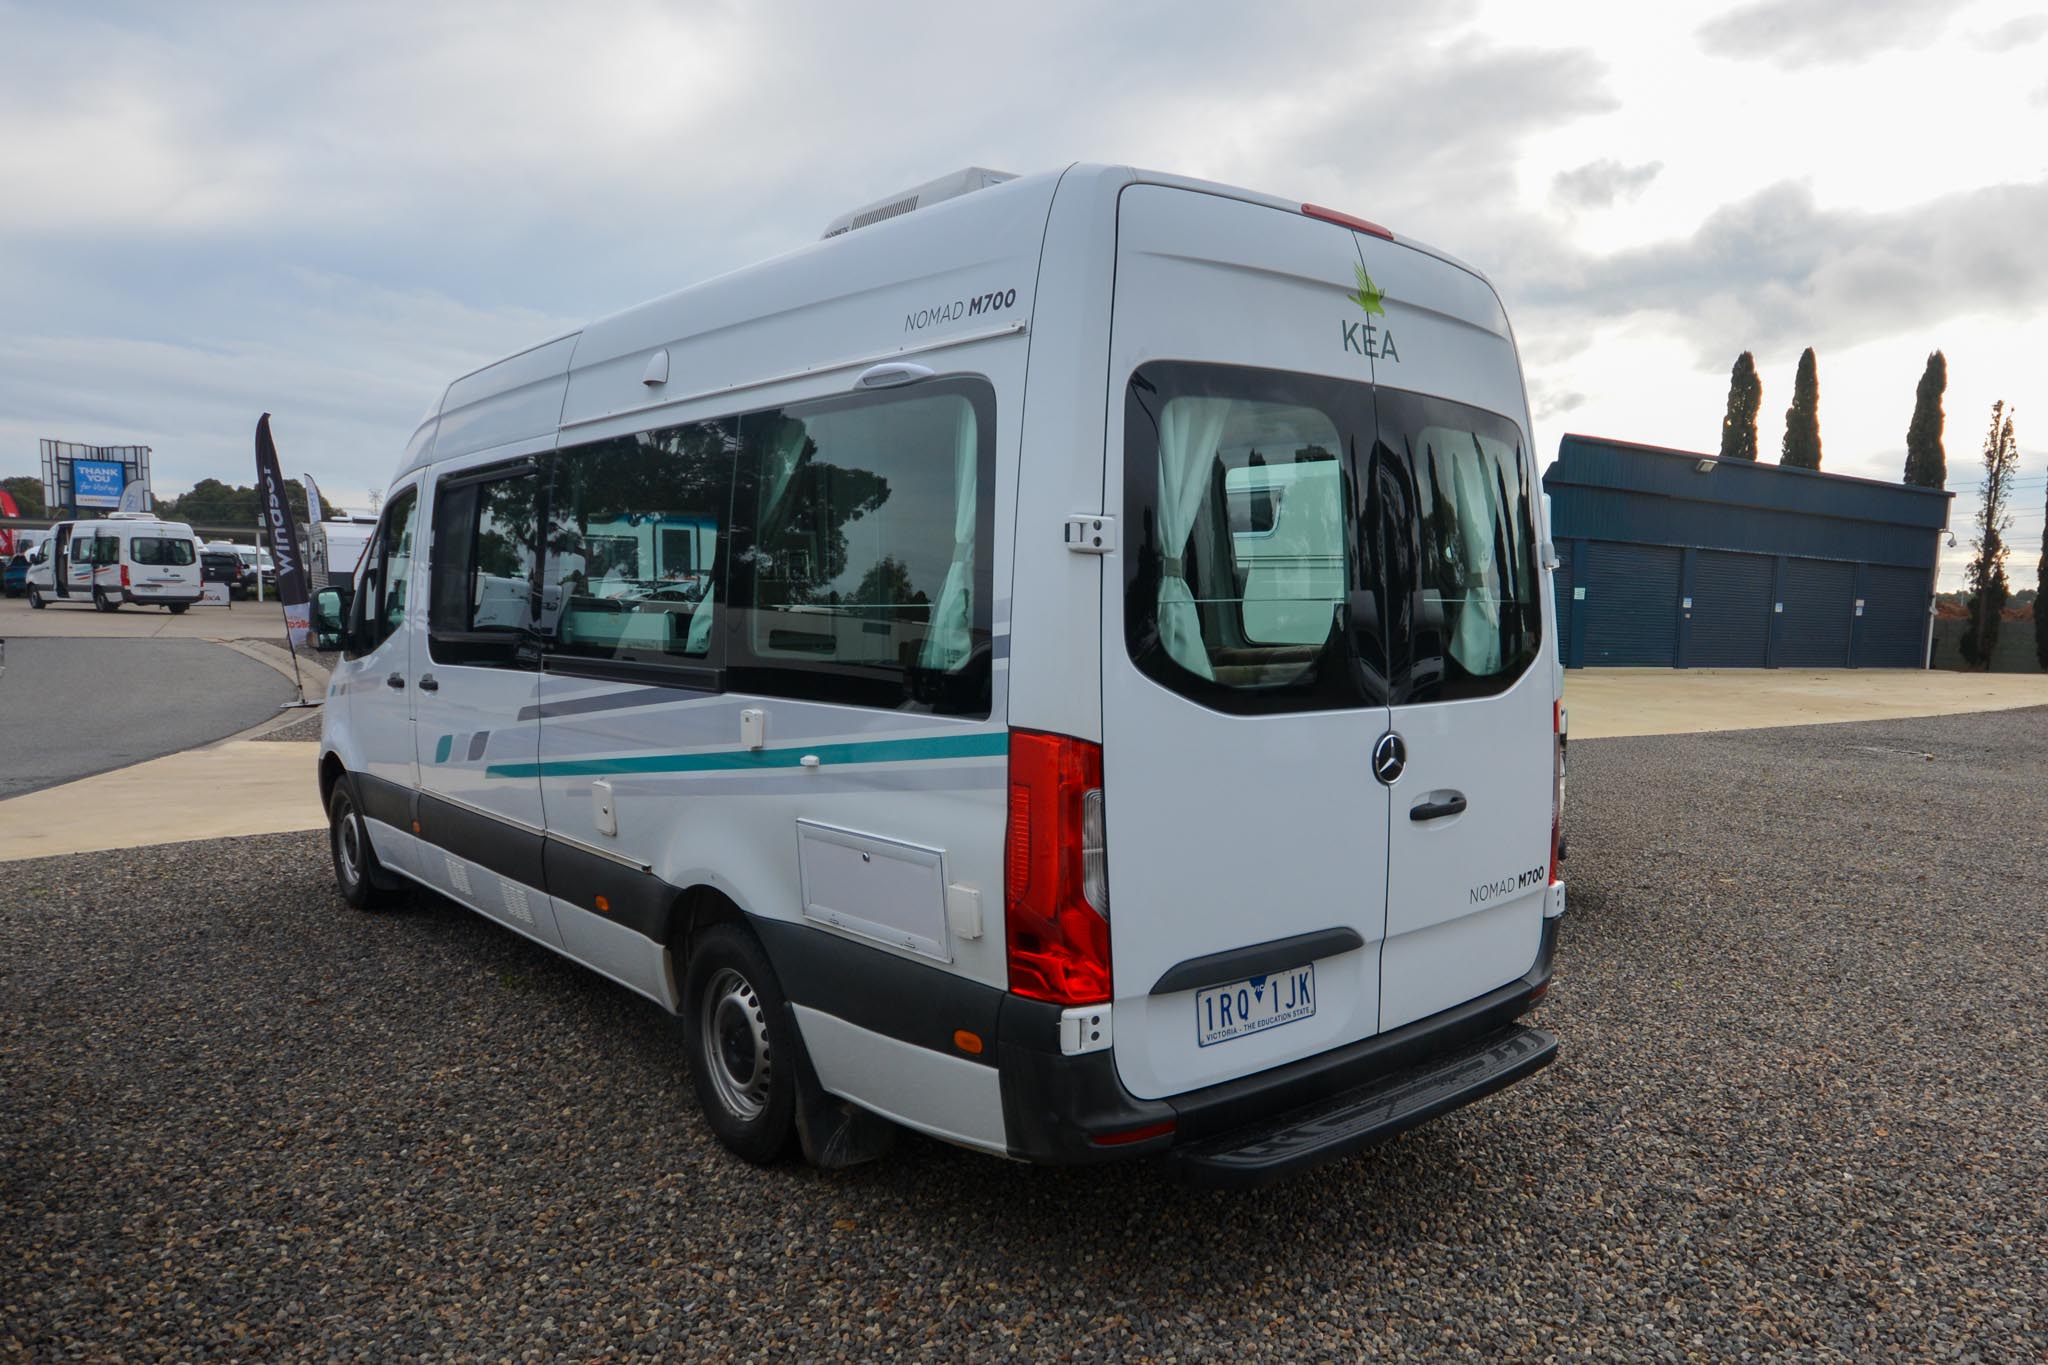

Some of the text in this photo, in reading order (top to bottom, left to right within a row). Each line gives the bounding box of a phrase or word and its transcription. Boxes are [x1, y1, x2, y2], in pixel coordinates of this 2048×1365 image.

[904, 288, 1016, 333] NOMAD M700
[1341, 319, 1400, 363] KEA
[78, 466, 118, 476] THANK
[87, 474, 111, 482] YOU
[1469, 865, 1544, 904] NOMAD M700
[1205, 972, 1311, 1031] 1RQ 1JK
[1206, 1027, 1238, 1041] VICTORIA
[1243, 1023, 1256, 1035] THE
[1257, 1012, 1292, 1028] EDUCATION
[1292, 1006, 1310, 1018] STATE
